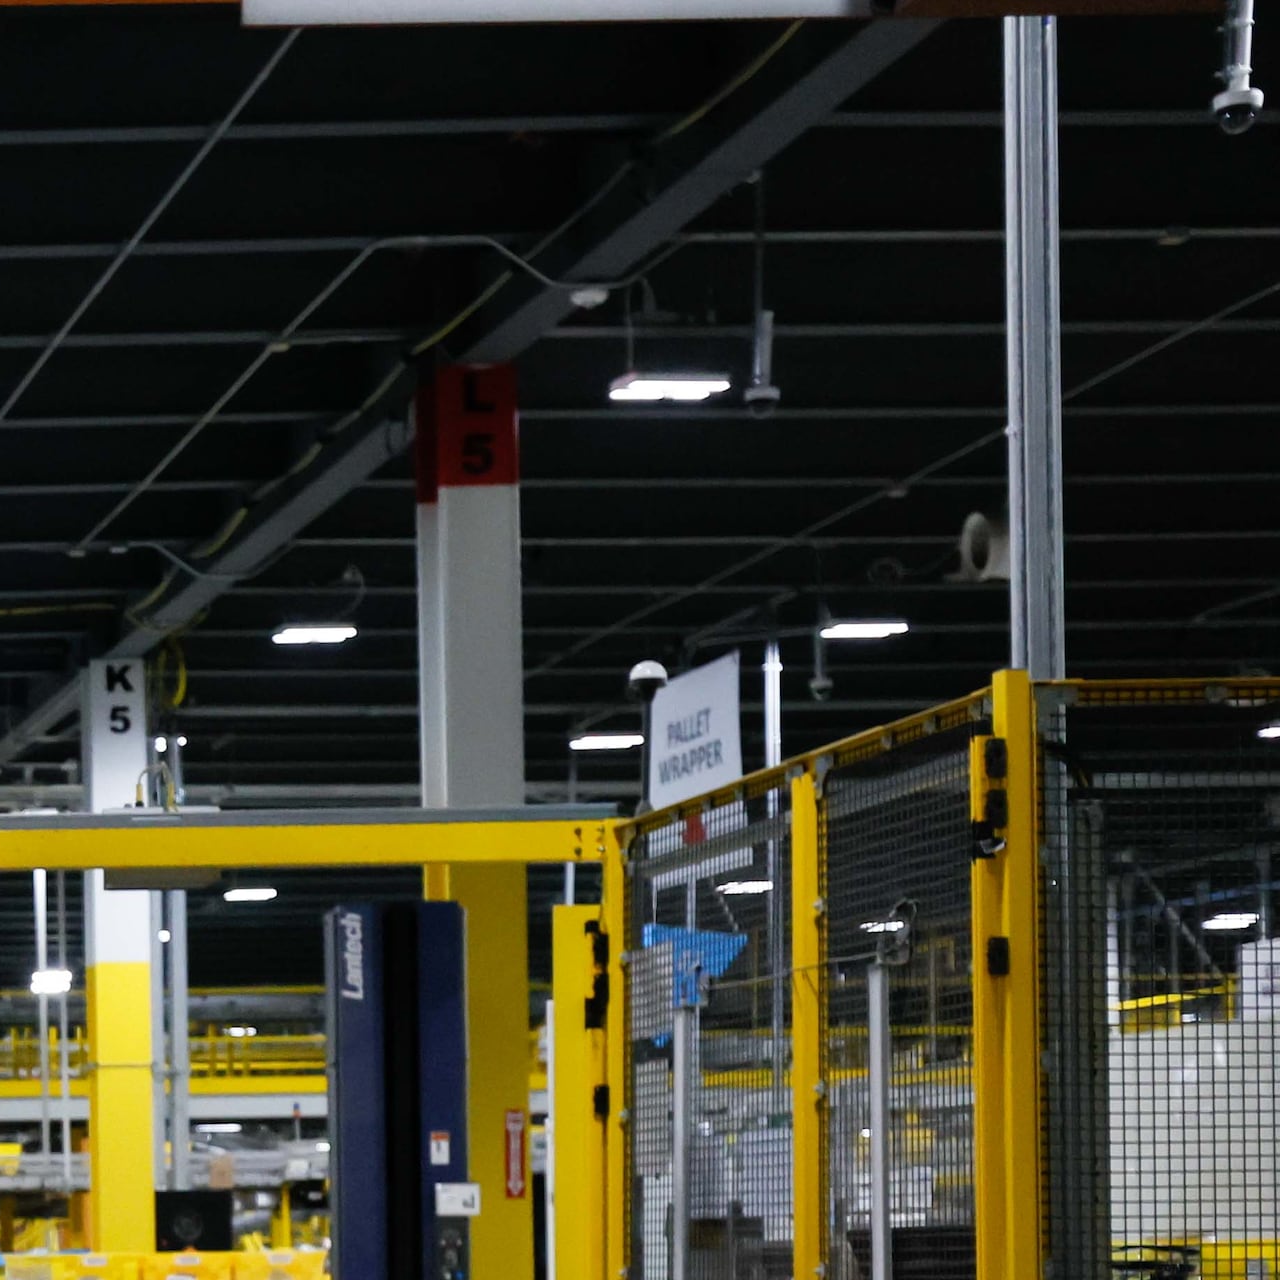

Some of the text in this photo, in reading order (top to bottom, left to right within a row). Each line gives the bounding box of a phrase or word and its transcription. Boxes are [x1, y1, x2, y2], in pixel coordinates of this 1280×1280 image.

[464, 372, 496, 412] L
[462, 433, 495, 475] 5
[106, 665, 134, 692] K
[110, 706, 130, 733] 5
[667, 706, 710, 750] PALLET
[659, 738, 723, 785] WRAPPER
[340, 910, 363, 999] Lantech
